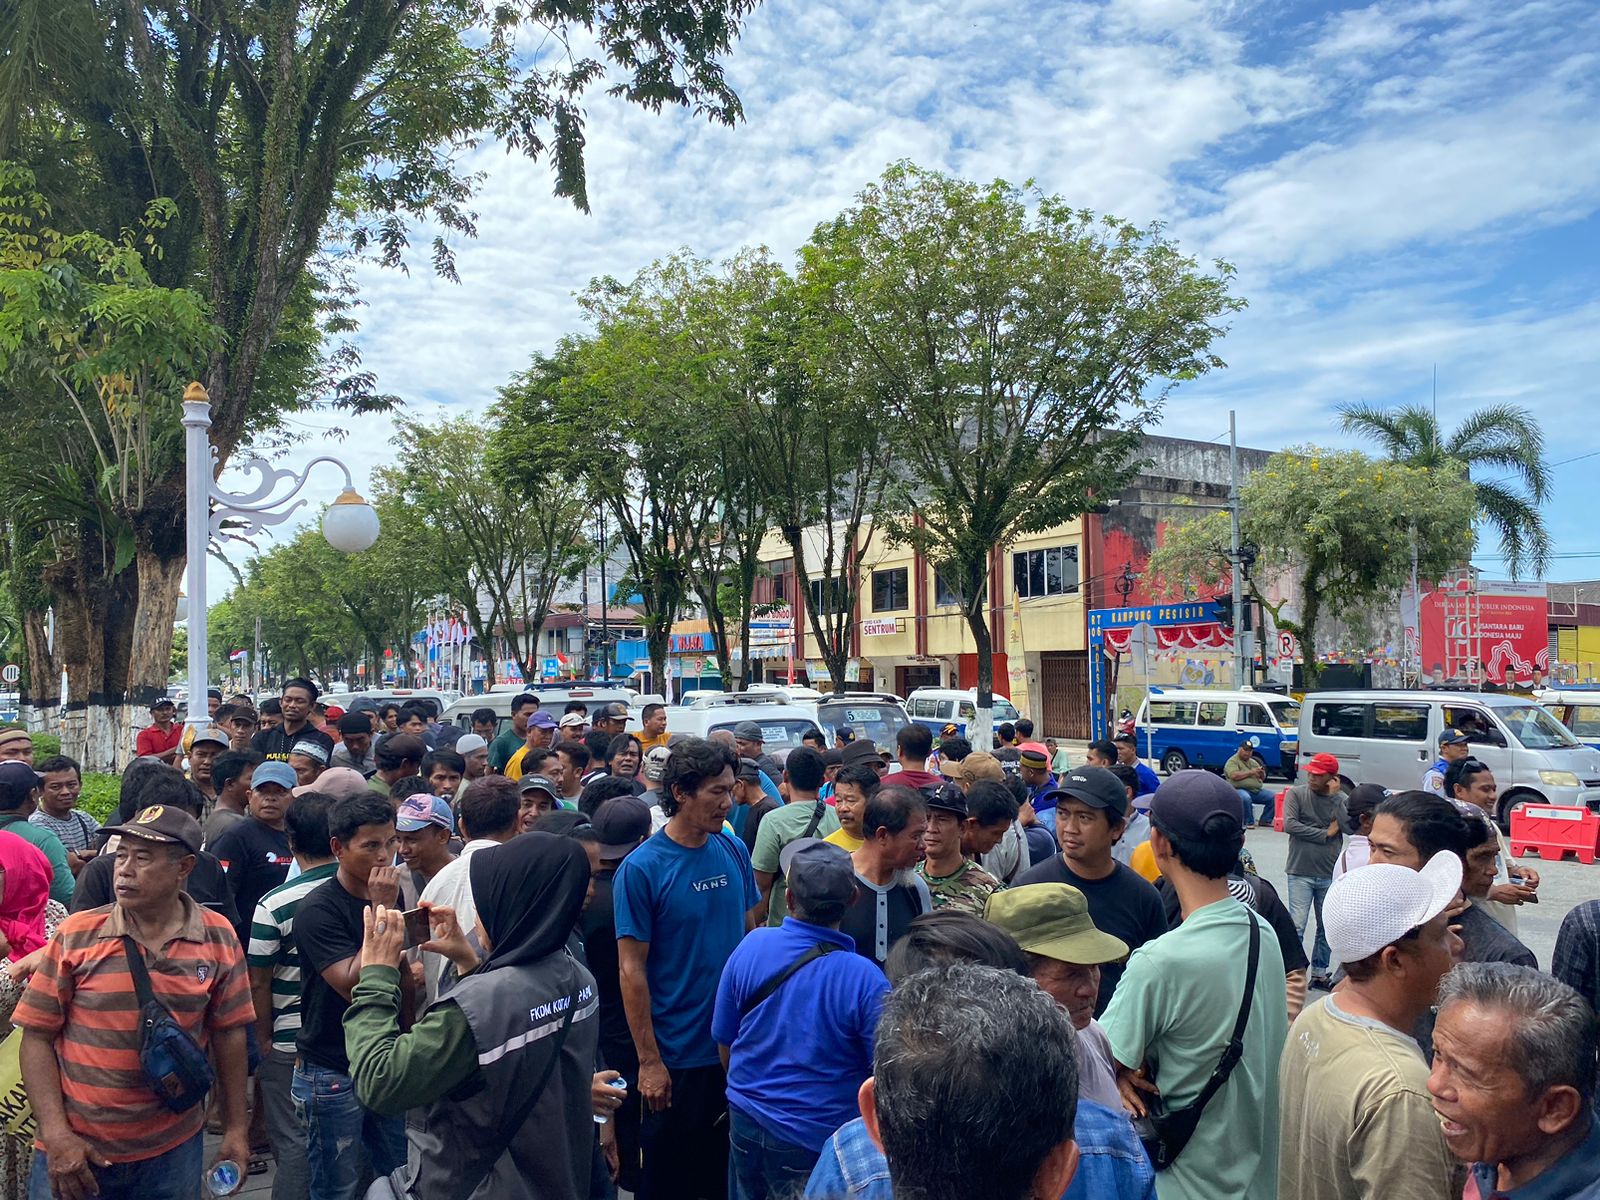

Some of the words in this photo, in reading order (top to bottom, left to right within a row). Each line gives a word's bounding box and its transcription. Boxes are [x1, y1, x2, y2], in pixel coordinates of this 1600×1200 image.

[1111, 611, 1152, 623] KAMPUNG
[1160, 606, 1204, 620] PESISIR
[864, 623, 896, 635] SENTRUM
[678, 635, 704, 650] WIJAYA
[847, 711, 855, 721] 5
[692, 874, 728, 892] VANS
[529, 1003, 552, 1022] FKDM
